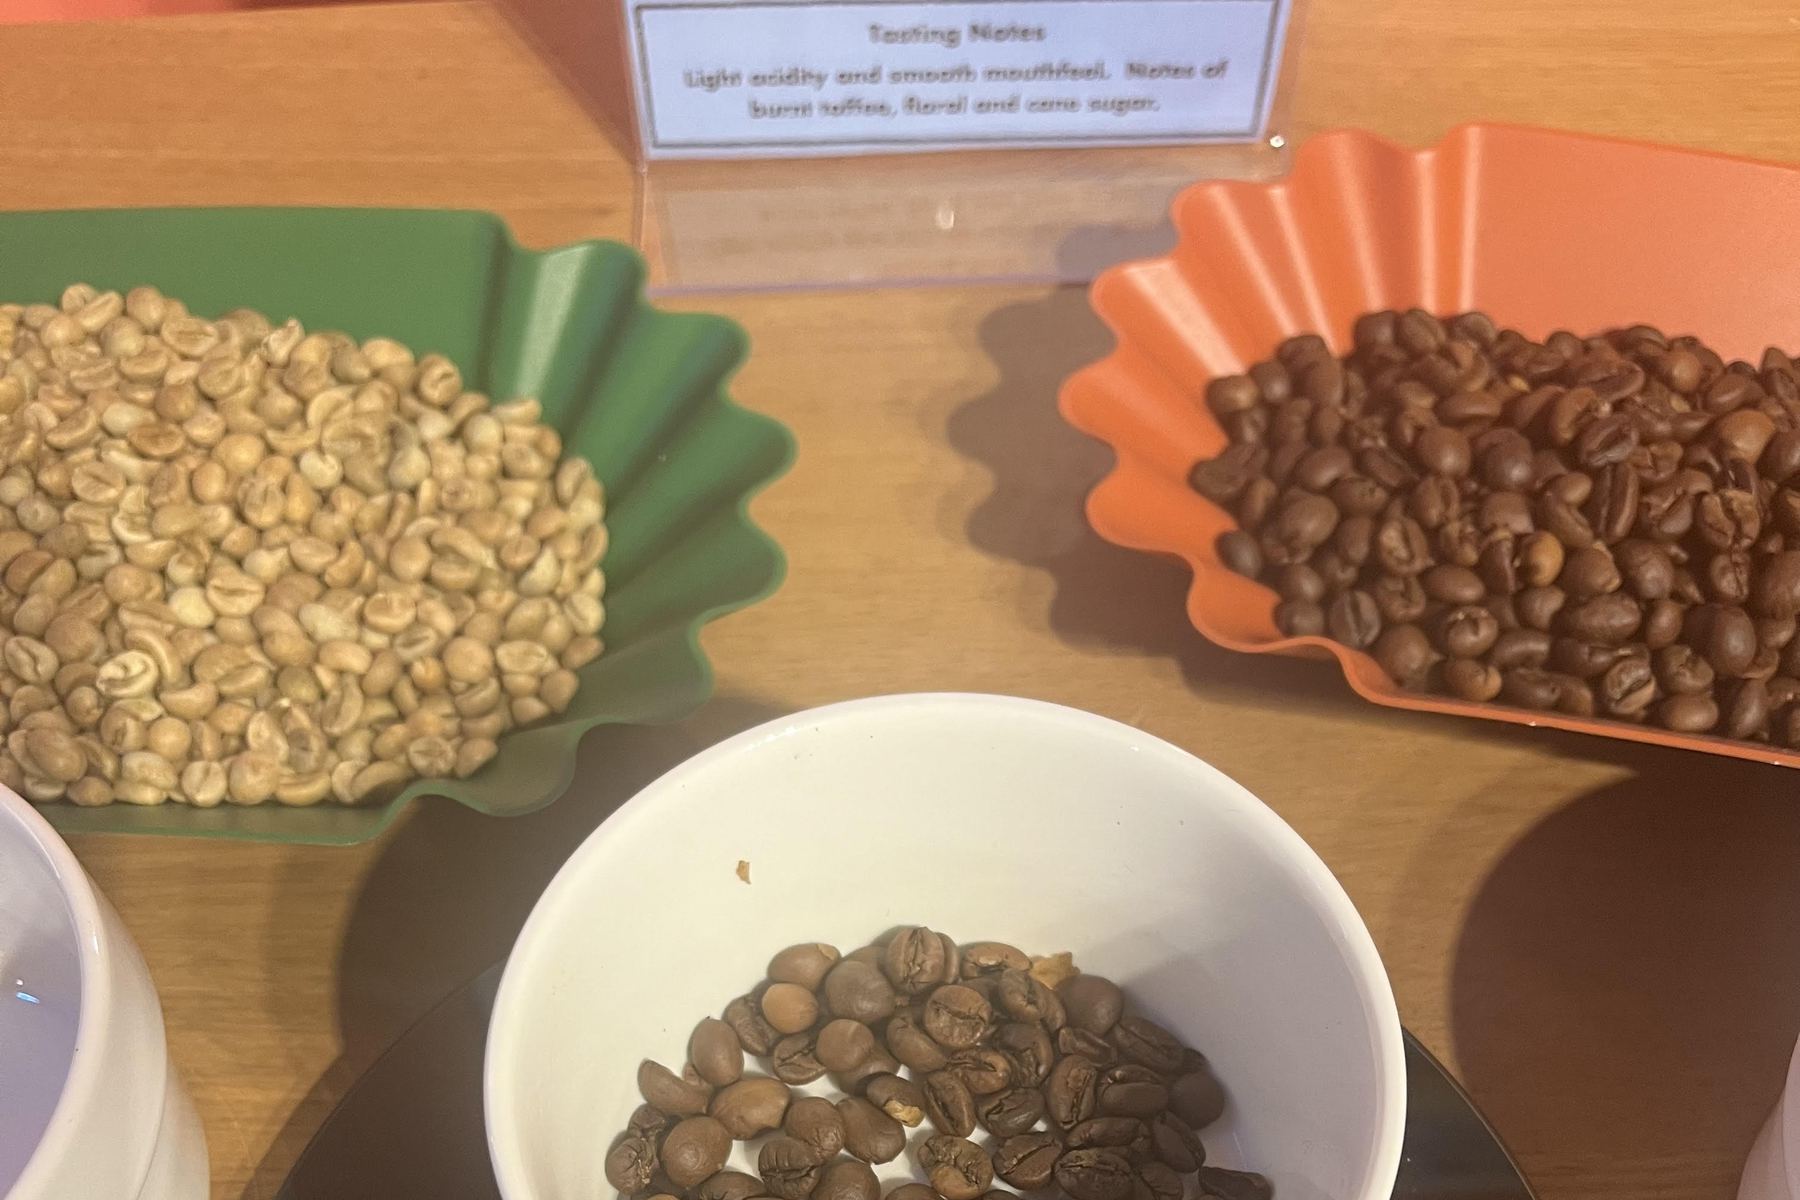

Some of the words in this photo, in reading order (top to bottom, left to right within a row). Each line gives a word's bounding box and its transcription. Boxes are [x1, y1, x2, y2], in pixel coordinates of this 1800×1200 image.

[868, 22, 961, 48] Tasting
[967, 23, 1047, 42] Notes
[683, 69, 742, 92] Light
[749, 68, 828, 91] acidity
[836, 65, 882, 85] and
[889, 64, 976, 85] smooth
[1124, 61, 1197, 79] Notes
[1201, 58, 1229, 79] of
[973, 94, 1022, 113] and
